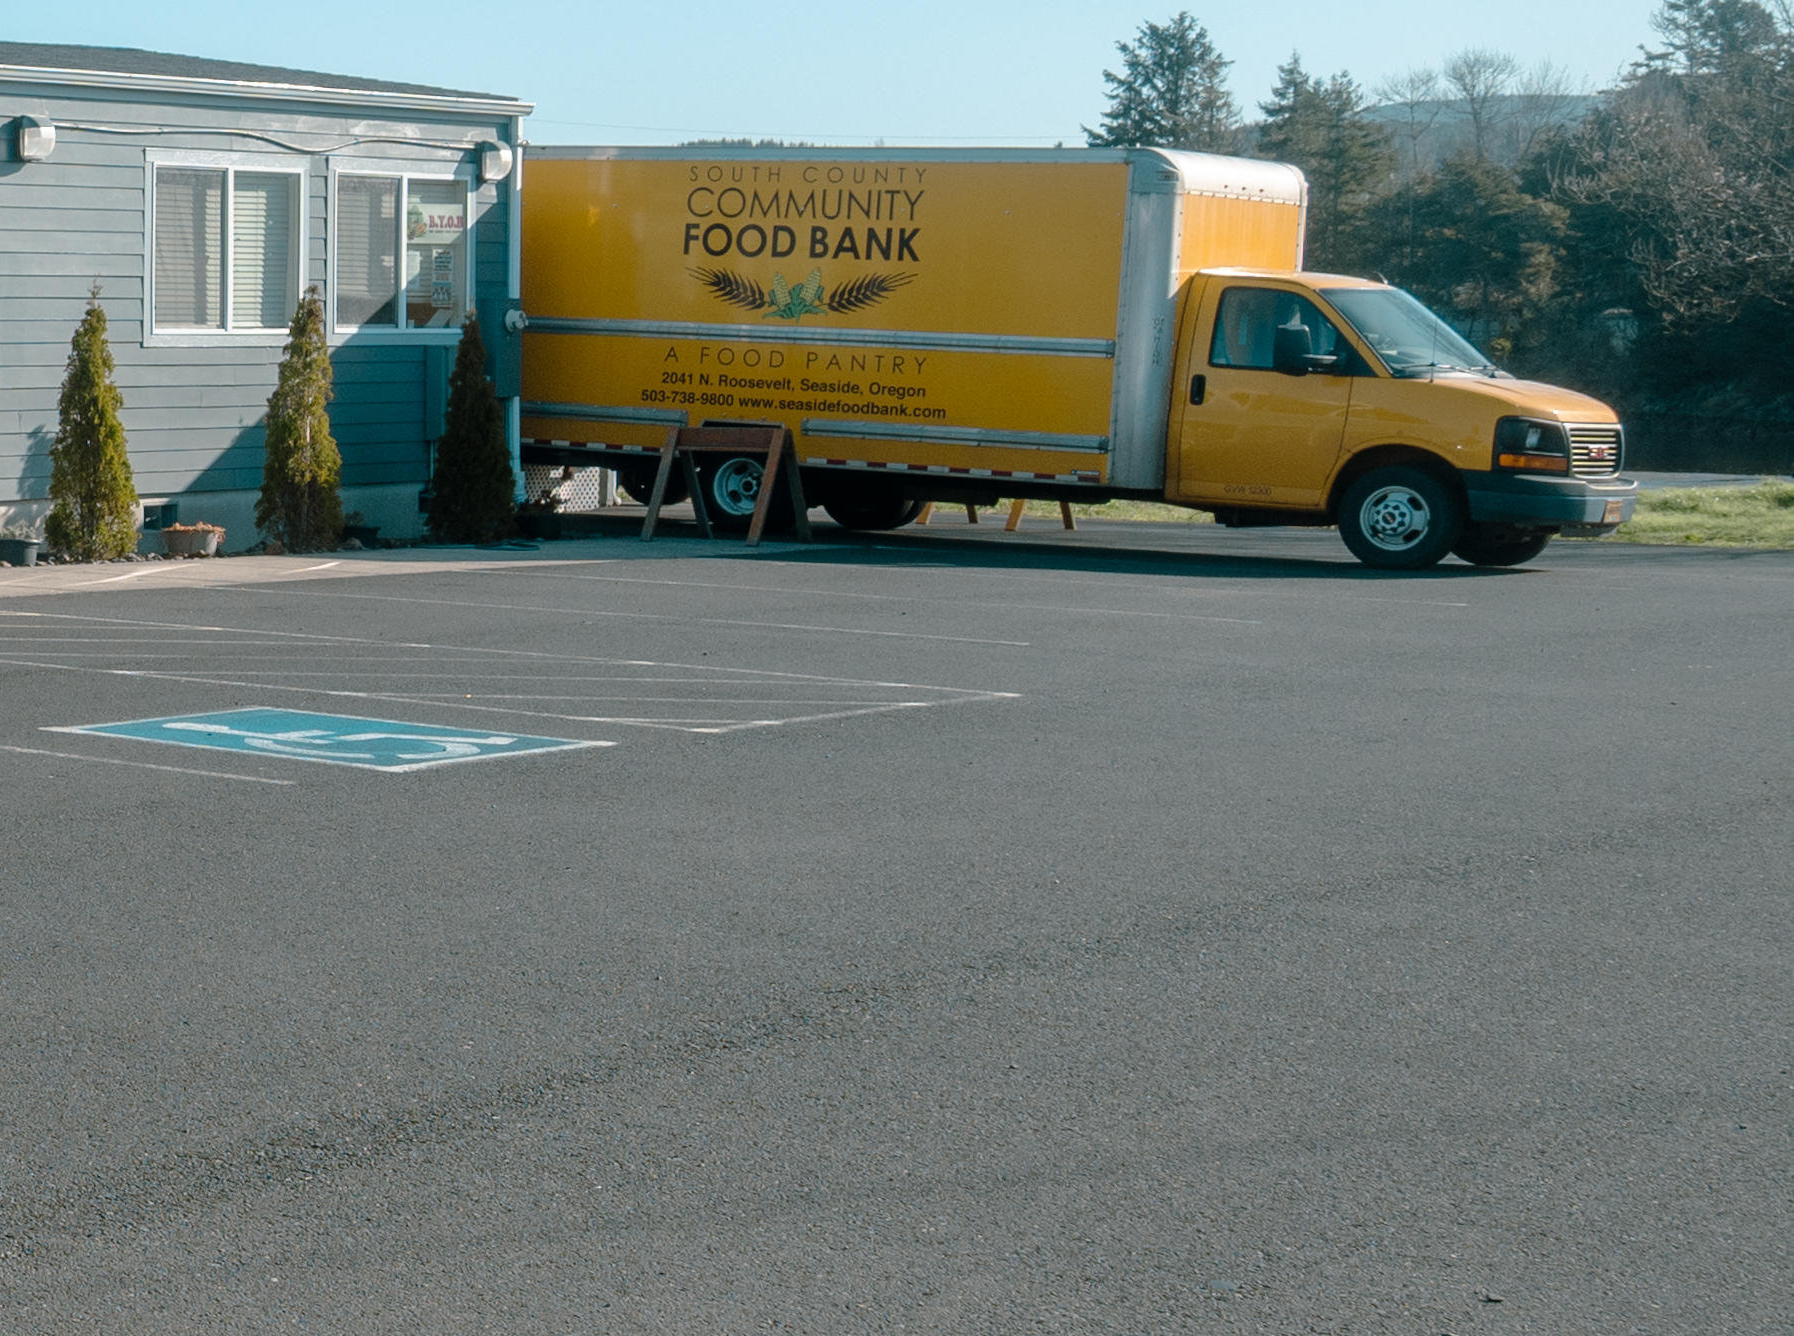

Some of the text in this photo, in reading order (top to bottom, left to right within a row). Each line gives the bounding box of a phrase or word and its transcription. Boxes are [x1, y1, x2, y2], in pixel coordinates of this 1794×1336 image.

[689, 166, 926, 183] SOUTH COUNTY
[687, 187, 925, 221] COMMUNITY
[683, 223, 921, 262] FOOD BANK
[664, 346, 927, 374] A FOOD PANTRY
[662, 371, 926, 399] 2041 N. Roosevelt, Seaside, Oregon
[641, 389, 946, 419] 503-738-9800 www.seasidefoodbank.com
